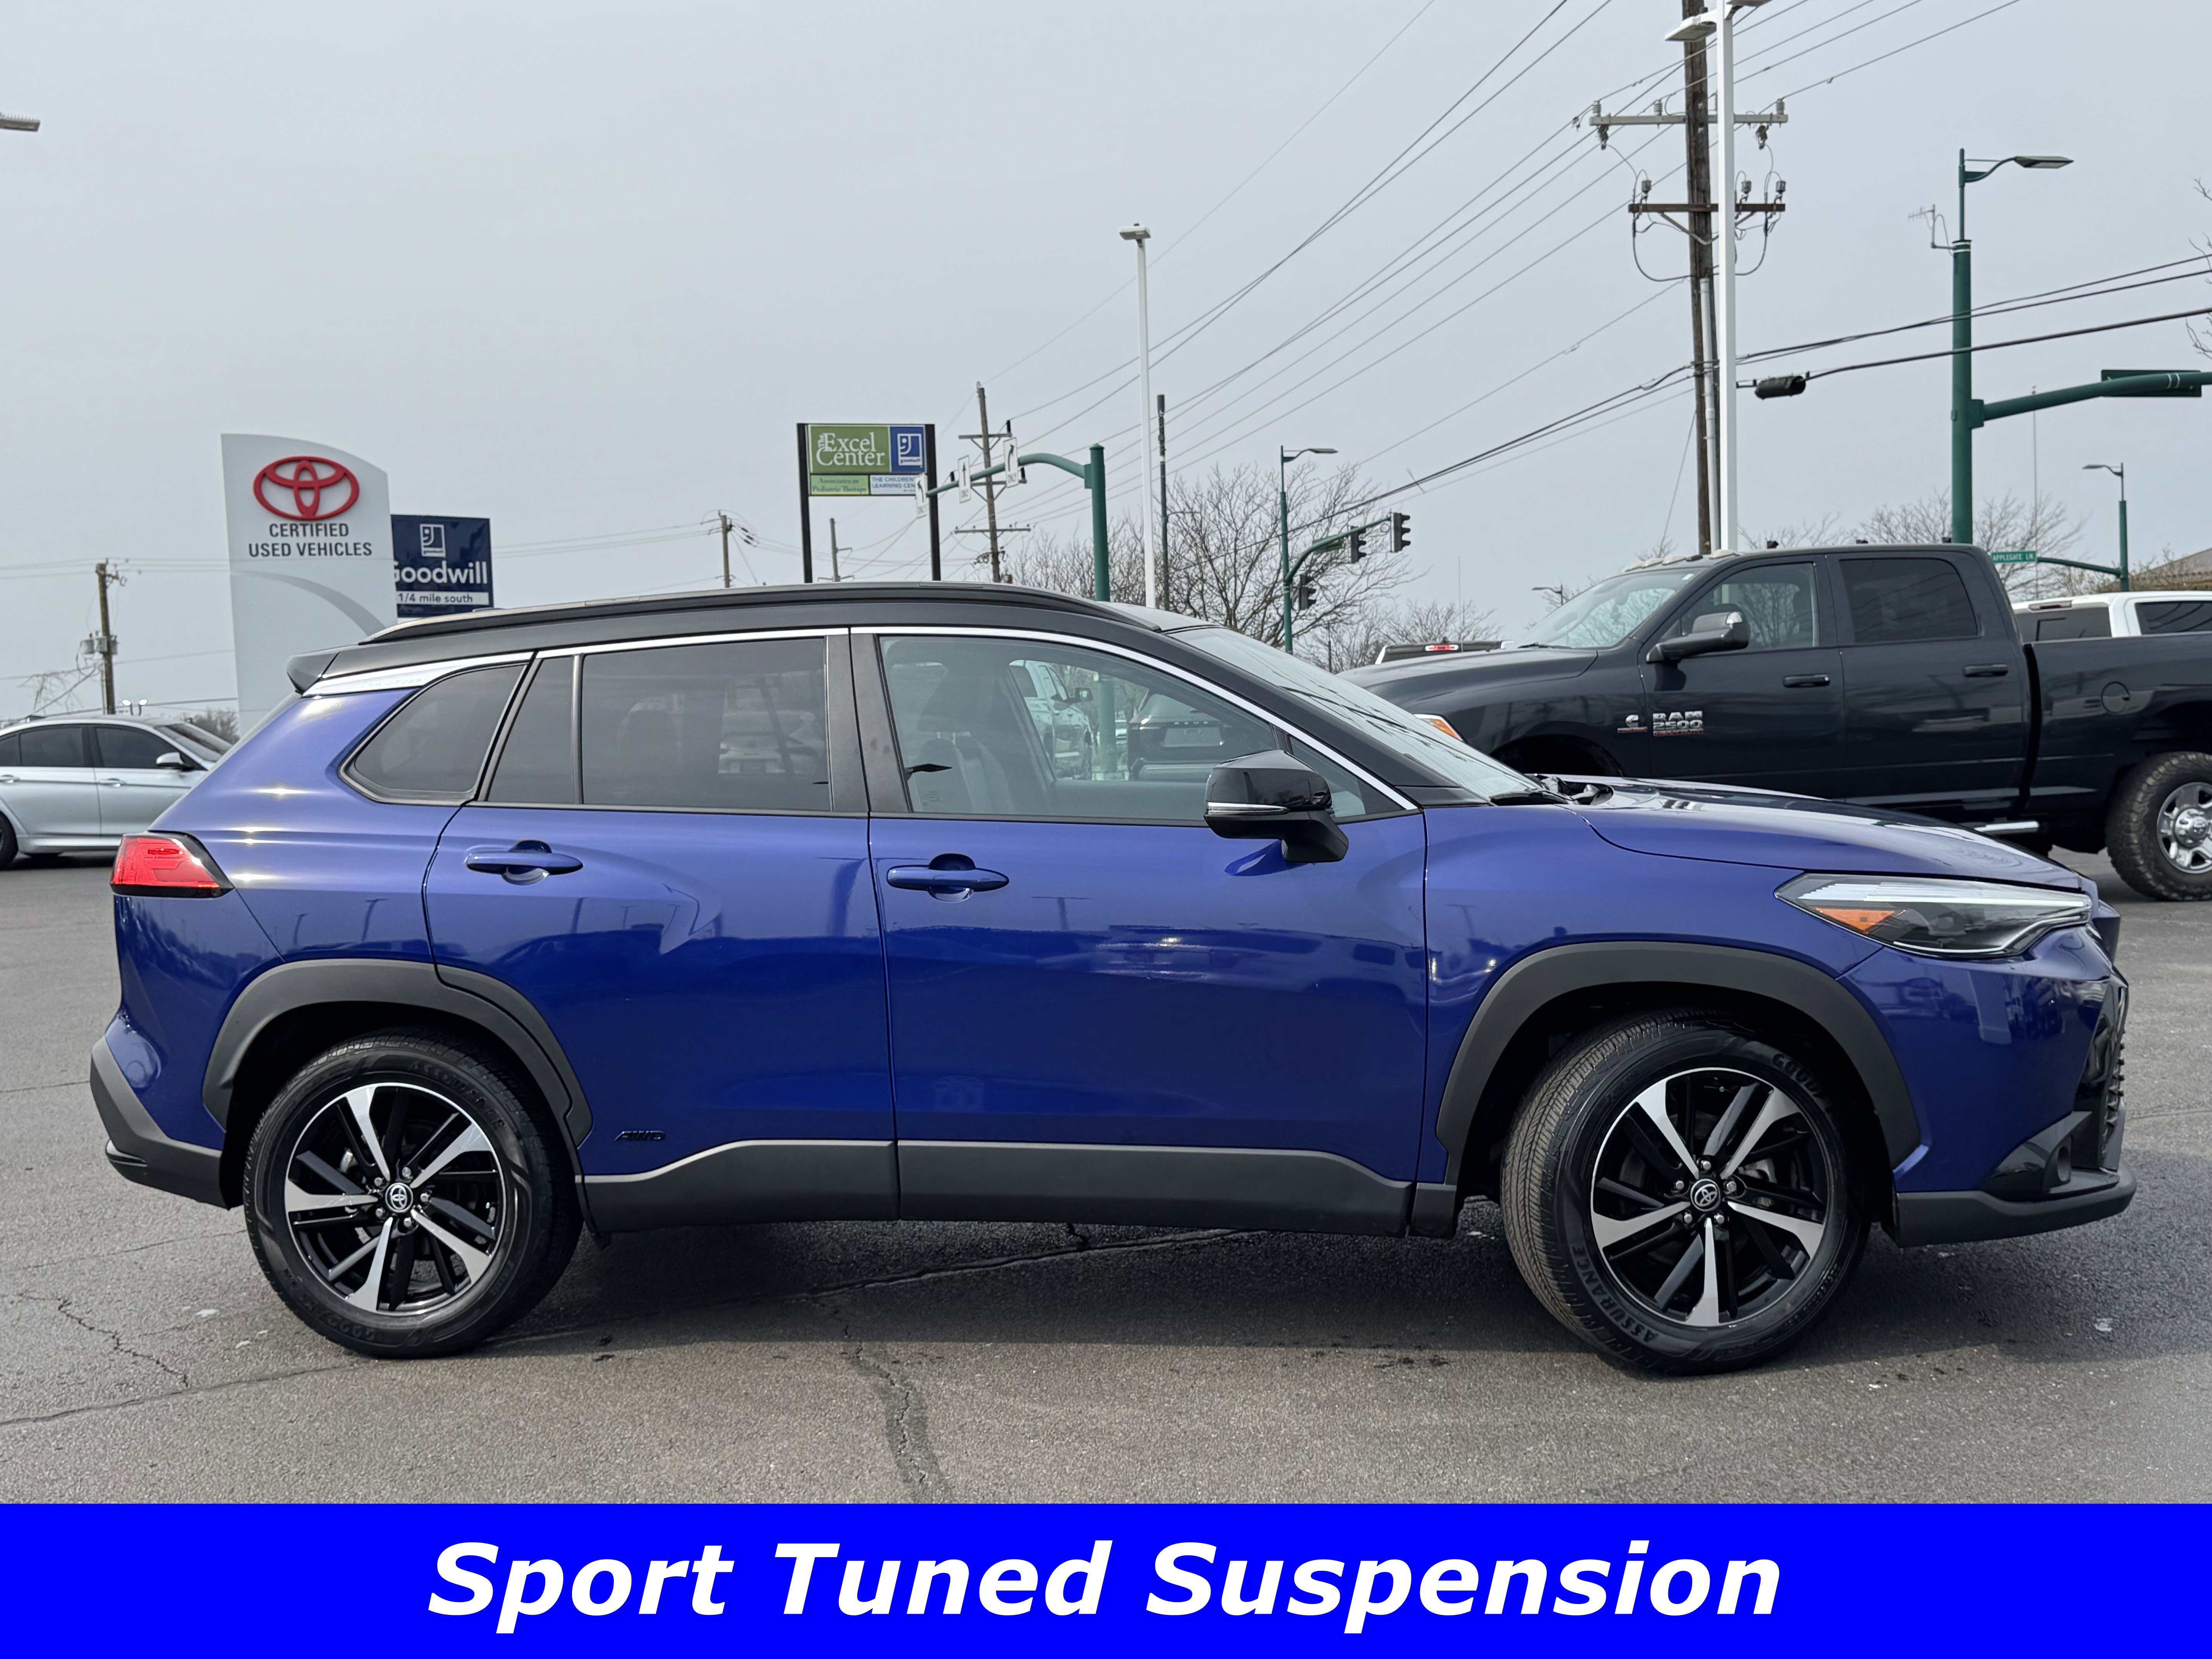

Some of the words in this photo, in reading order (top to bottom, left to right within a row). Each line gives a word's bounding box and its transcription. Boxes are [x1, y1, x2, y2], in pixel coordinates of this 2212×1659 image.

[823, 432, 877, 452] Excel
[816, 447, 885, 466] Center
[269, 522, 349, 537] CERTIFIED
[248, 543, 291, 557] USED
[296, 542, 373, 556] VEHICLES
[1992, 553, 2022, 561] APPLEGATE
[399, 593, 416, 603] 1/4
[419, 594, 441, 603] mile
[445, 594, 473, 603] south
[1652, 711, 1702, 722] RAM
[1653, 720, 1703, 730] 2500
[614, 1130, 666, 1142] AWD
[1572, 1245, 1659, 1343] ASSURANCE
